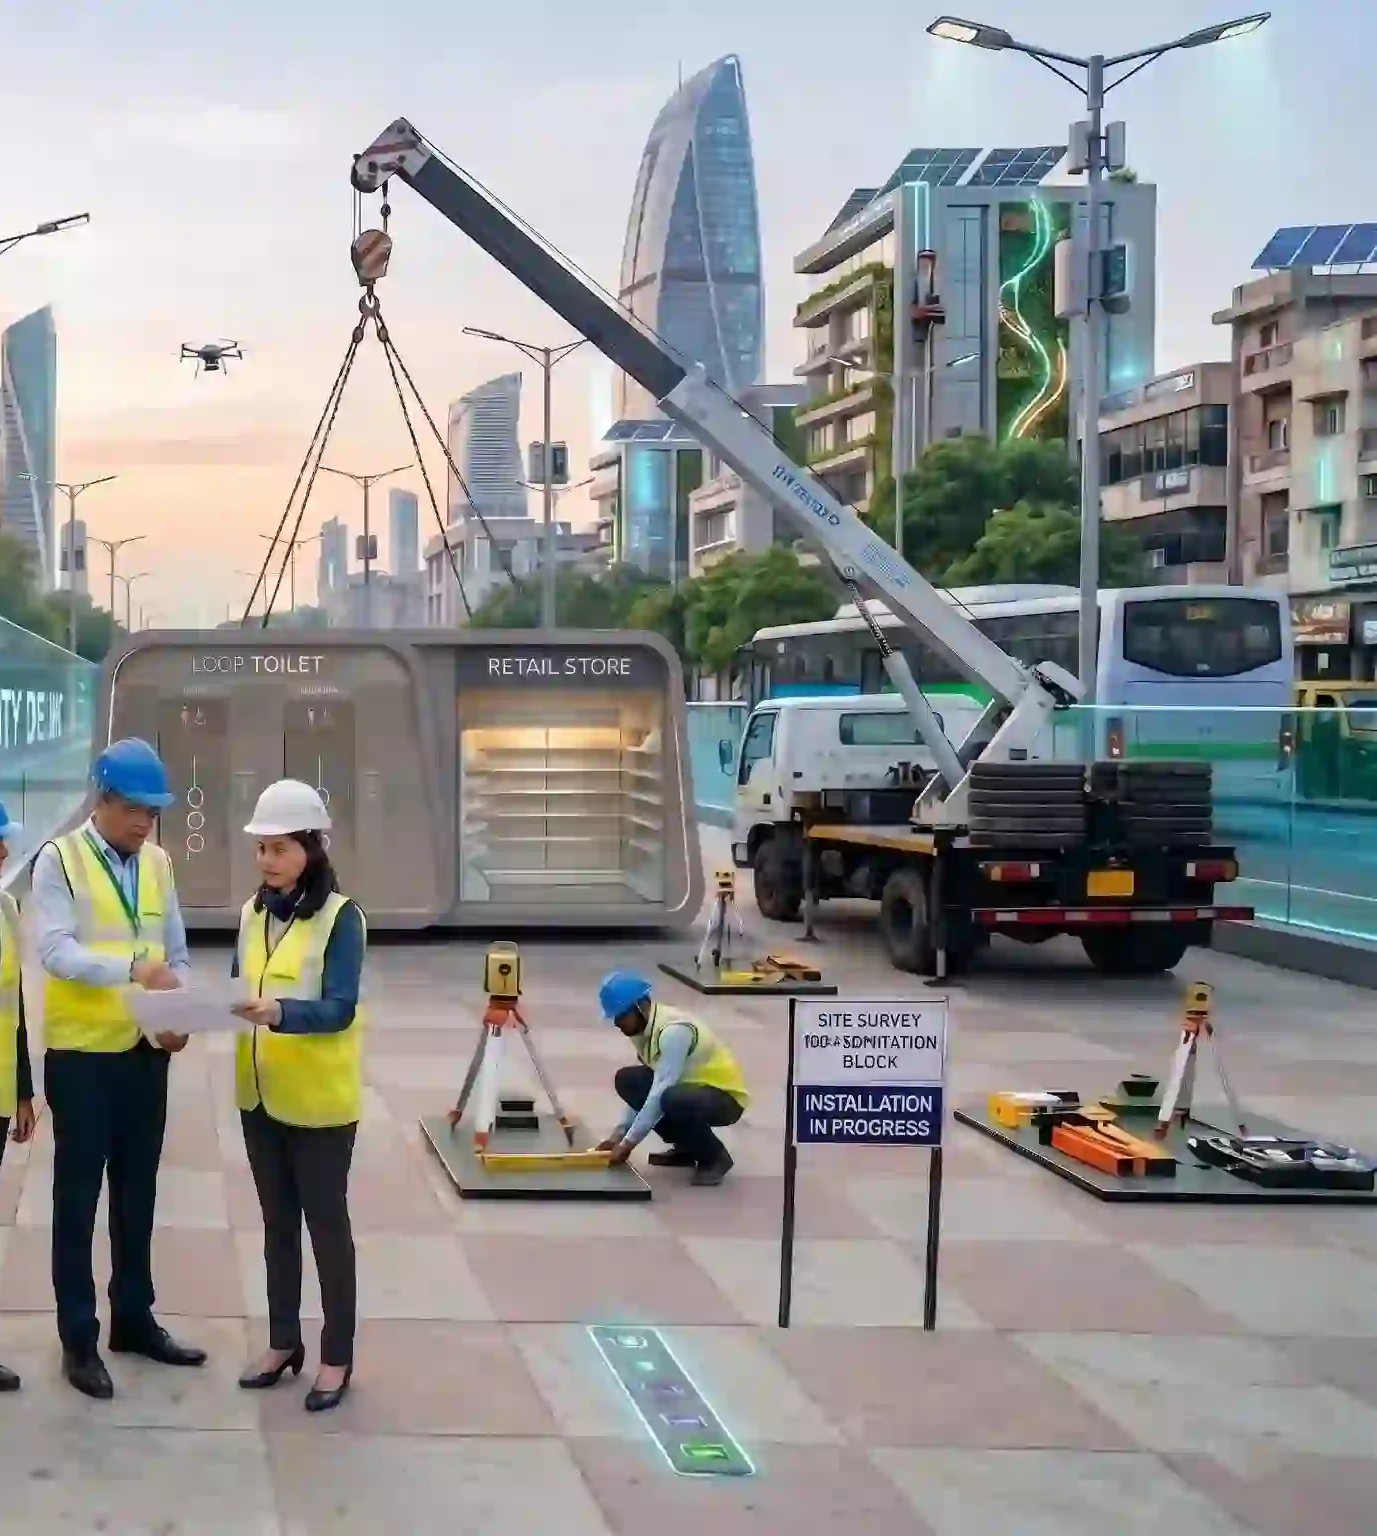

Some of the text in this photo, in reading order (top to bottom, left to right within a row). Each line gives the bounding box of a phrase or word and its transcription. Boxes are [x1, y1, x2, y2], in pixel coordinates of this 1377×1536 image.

[192, 654, 323, 673] LOOP TOILET
[488, 657, 631, 676] RETAIL STORE
[818, 1013, 922, 1028] SITE SURVEY
[843, 1055, 898, 1069] BLOCK
[805, 1094, 933, 1114] INSTALLATION
[810, 1118, 930, 1137] IN PROGRESS
